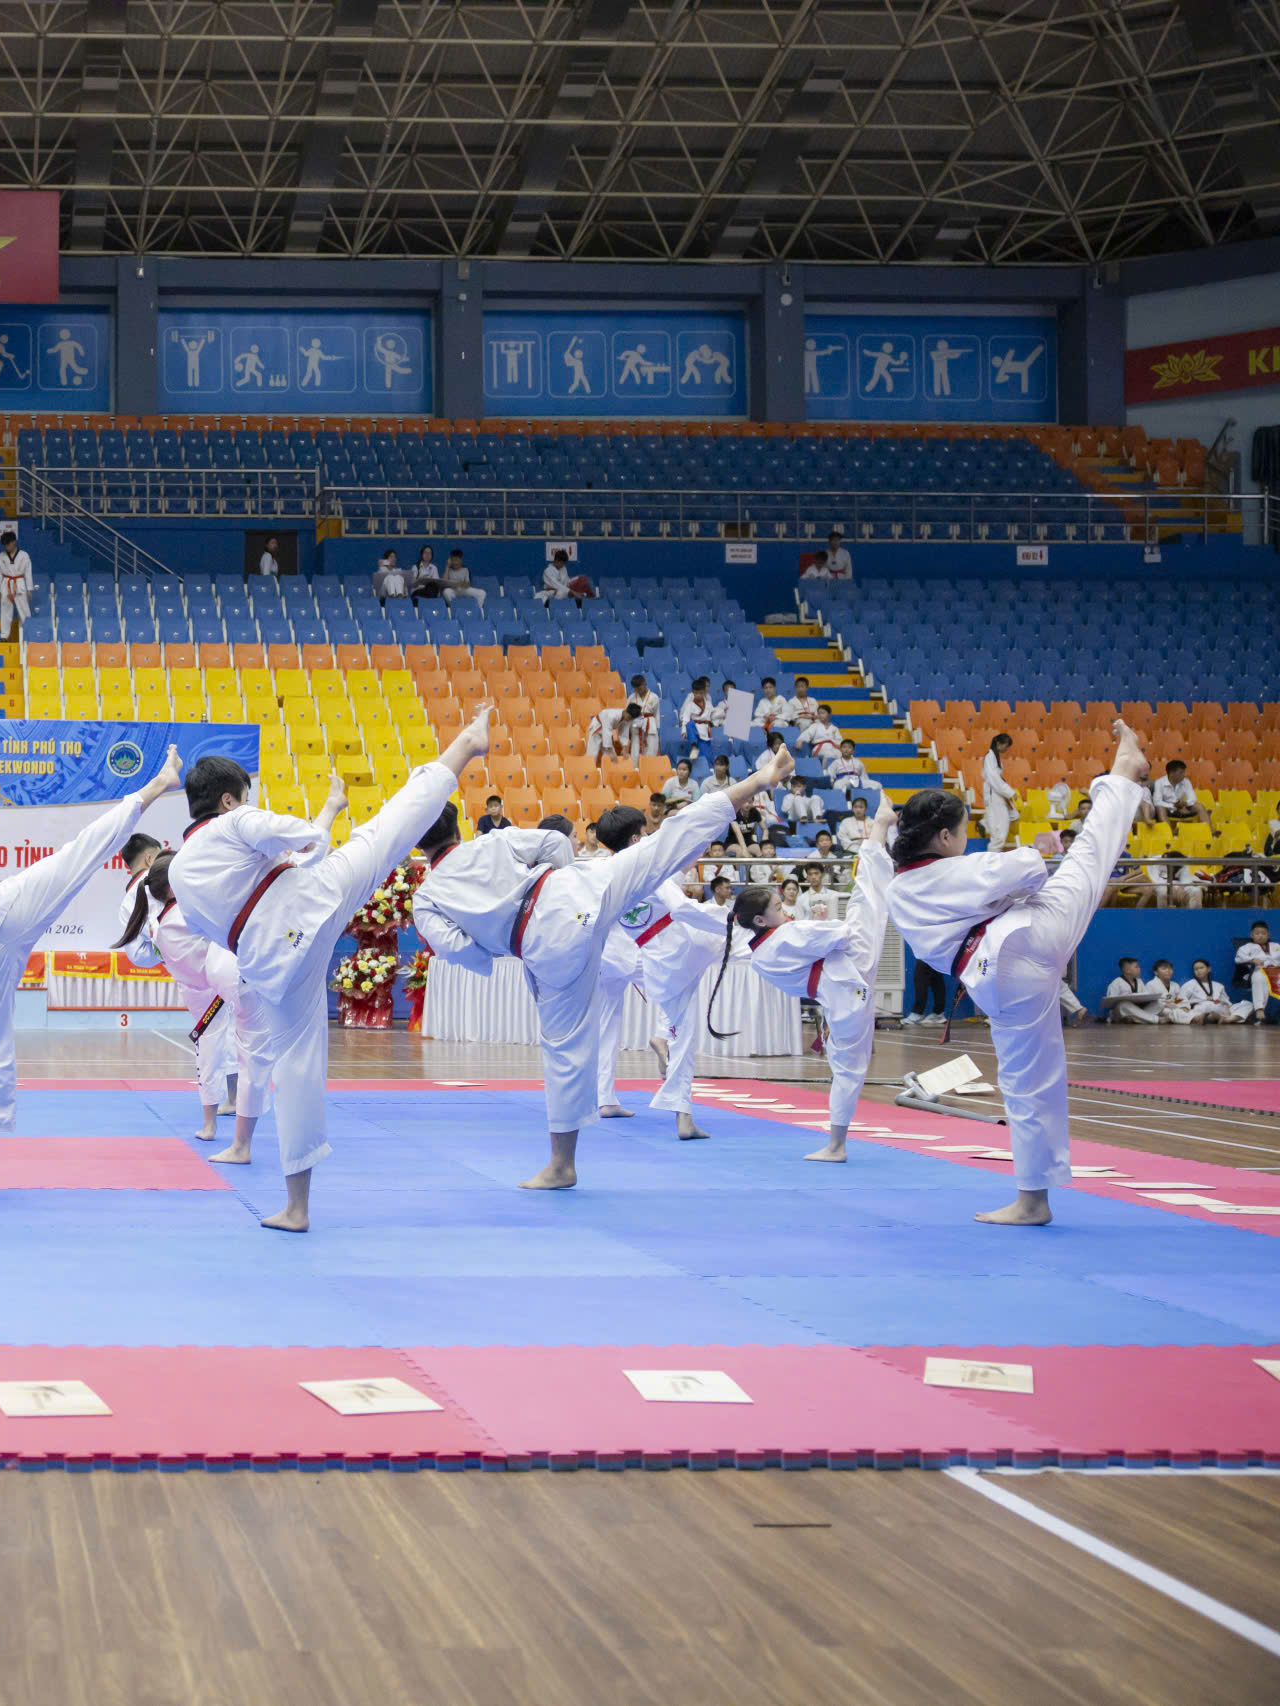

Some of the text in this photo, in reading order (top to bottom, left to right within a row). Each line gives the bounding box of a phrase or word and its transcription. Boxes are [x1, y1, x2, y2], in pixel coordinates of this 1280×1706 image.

[2, 736, 29, 754] TỈNH
[33, 737, 56, 754] PHÚ
[60, 741, 83, 758] THỌ
[55, 924, 84, 935] 2026
[120, 1013, 128, 1027] 3
